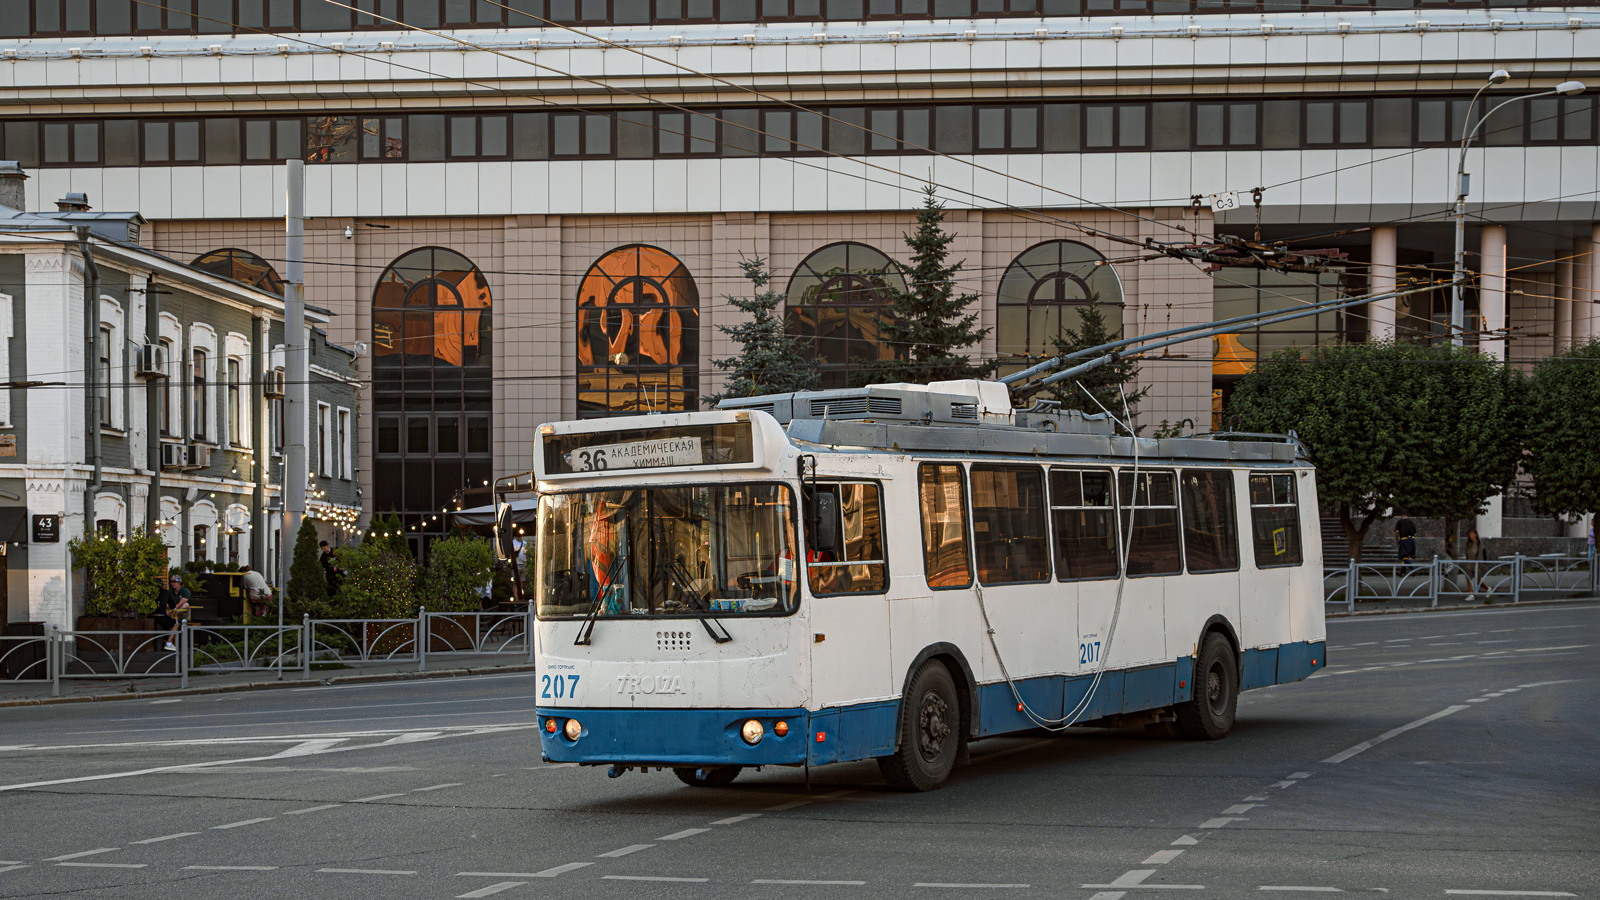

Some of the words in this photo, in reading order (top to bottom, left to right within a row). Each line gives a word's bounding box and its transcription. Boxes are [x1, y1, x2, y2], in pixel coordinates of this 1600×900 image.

[611, 440, 694, 458] АКАДЕМИЧЕСКАЯ
[578, 450, 608, 472] 36
[632, 455, 674, 468] ХИММАШ
[38, 517, 52, 528] 43
[1080, 641, 1101, 664] 207
[541, 674, 580, 699] 207
[617, 675, 687, 695] TROLZA
